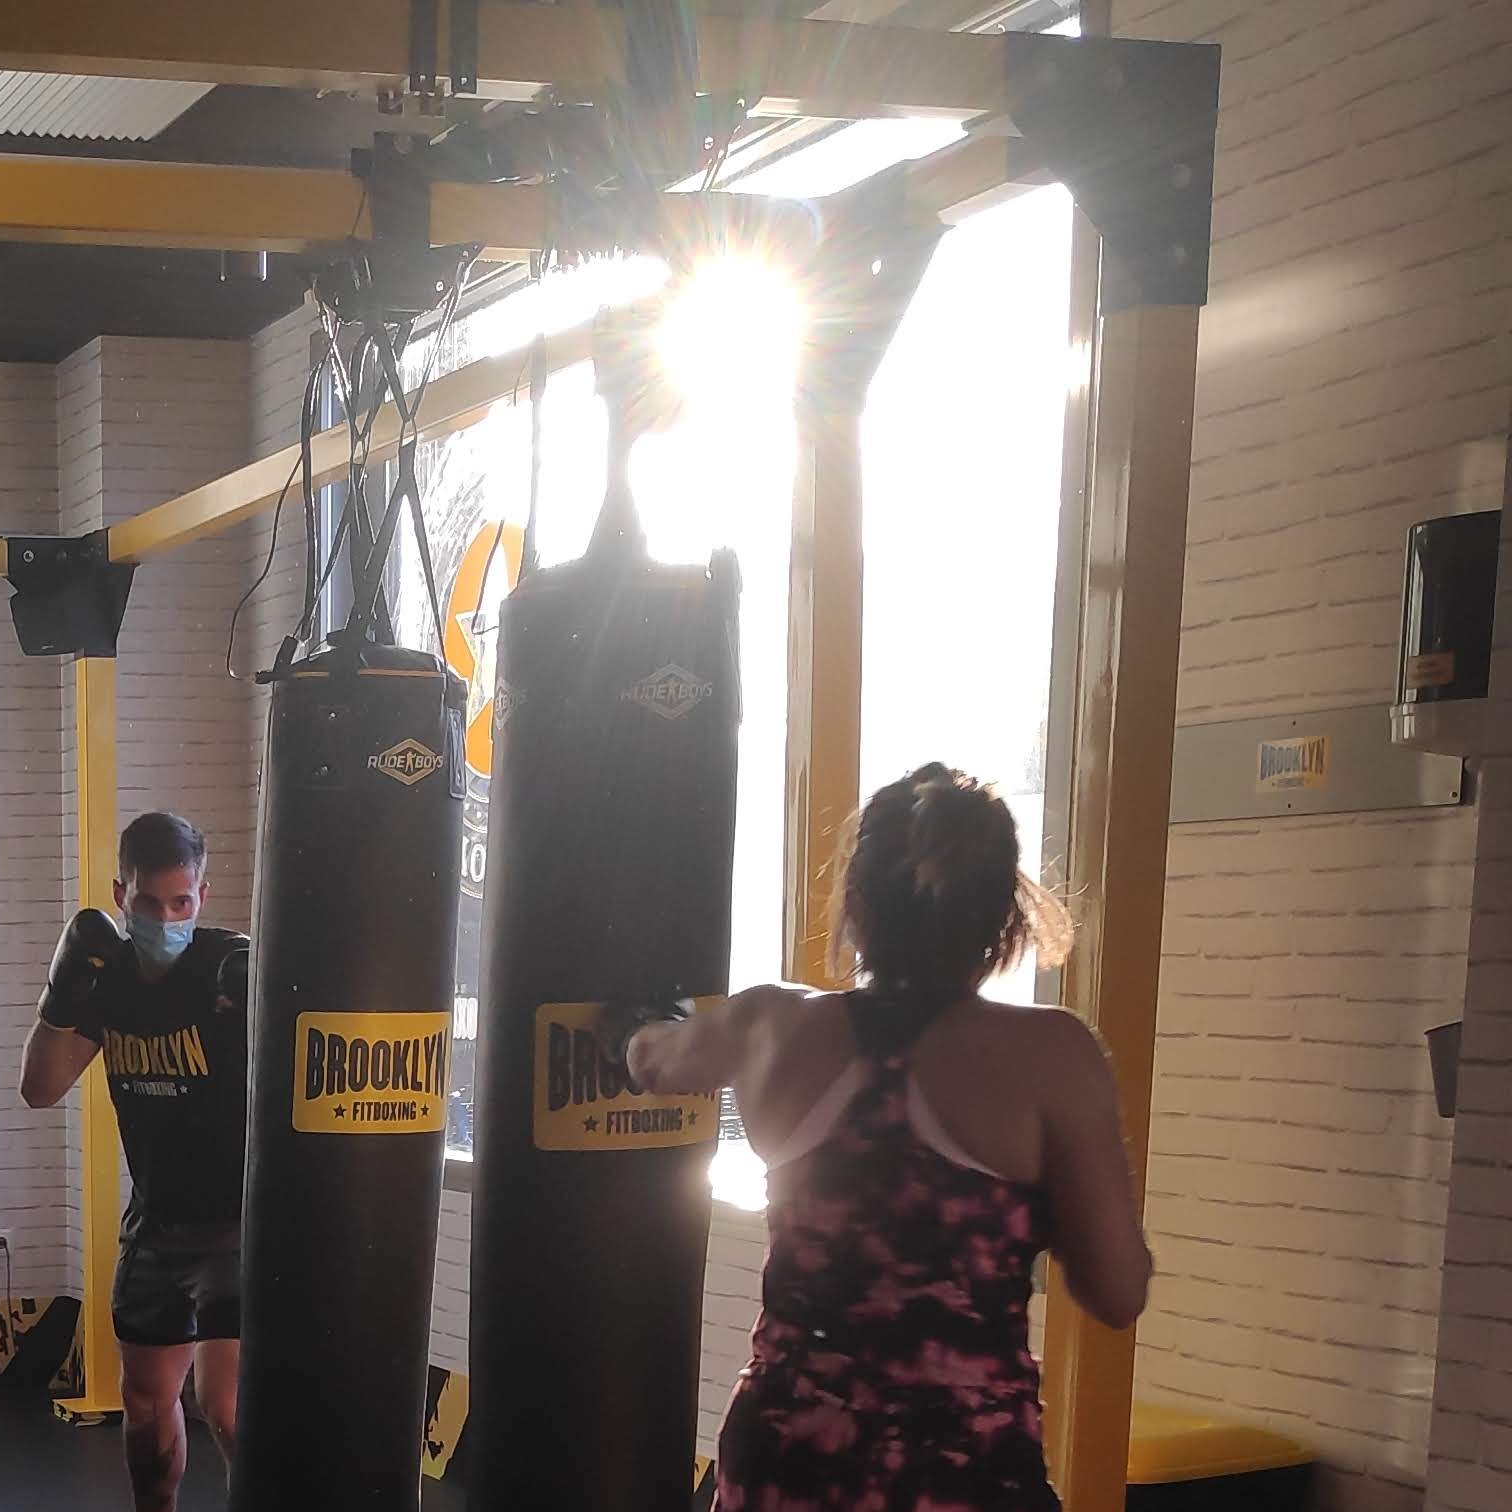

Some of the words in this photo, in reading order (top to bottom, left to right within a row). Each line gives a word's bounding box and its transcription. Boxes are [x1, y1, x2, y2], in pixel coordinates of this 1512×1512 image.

[678, 681, 713, 700] BOYS
[368, 755, 406, 768] RUDE
[415, 755, 443, 768] BOYS
[1260, 737, 1325, 780] BROOKLYN
[305, 1027, 448, 1101] BROOKLYN
[352, 1101, 417, 1122] FITBOXING
[606, 1107, 683, 1135] FITBOXING
